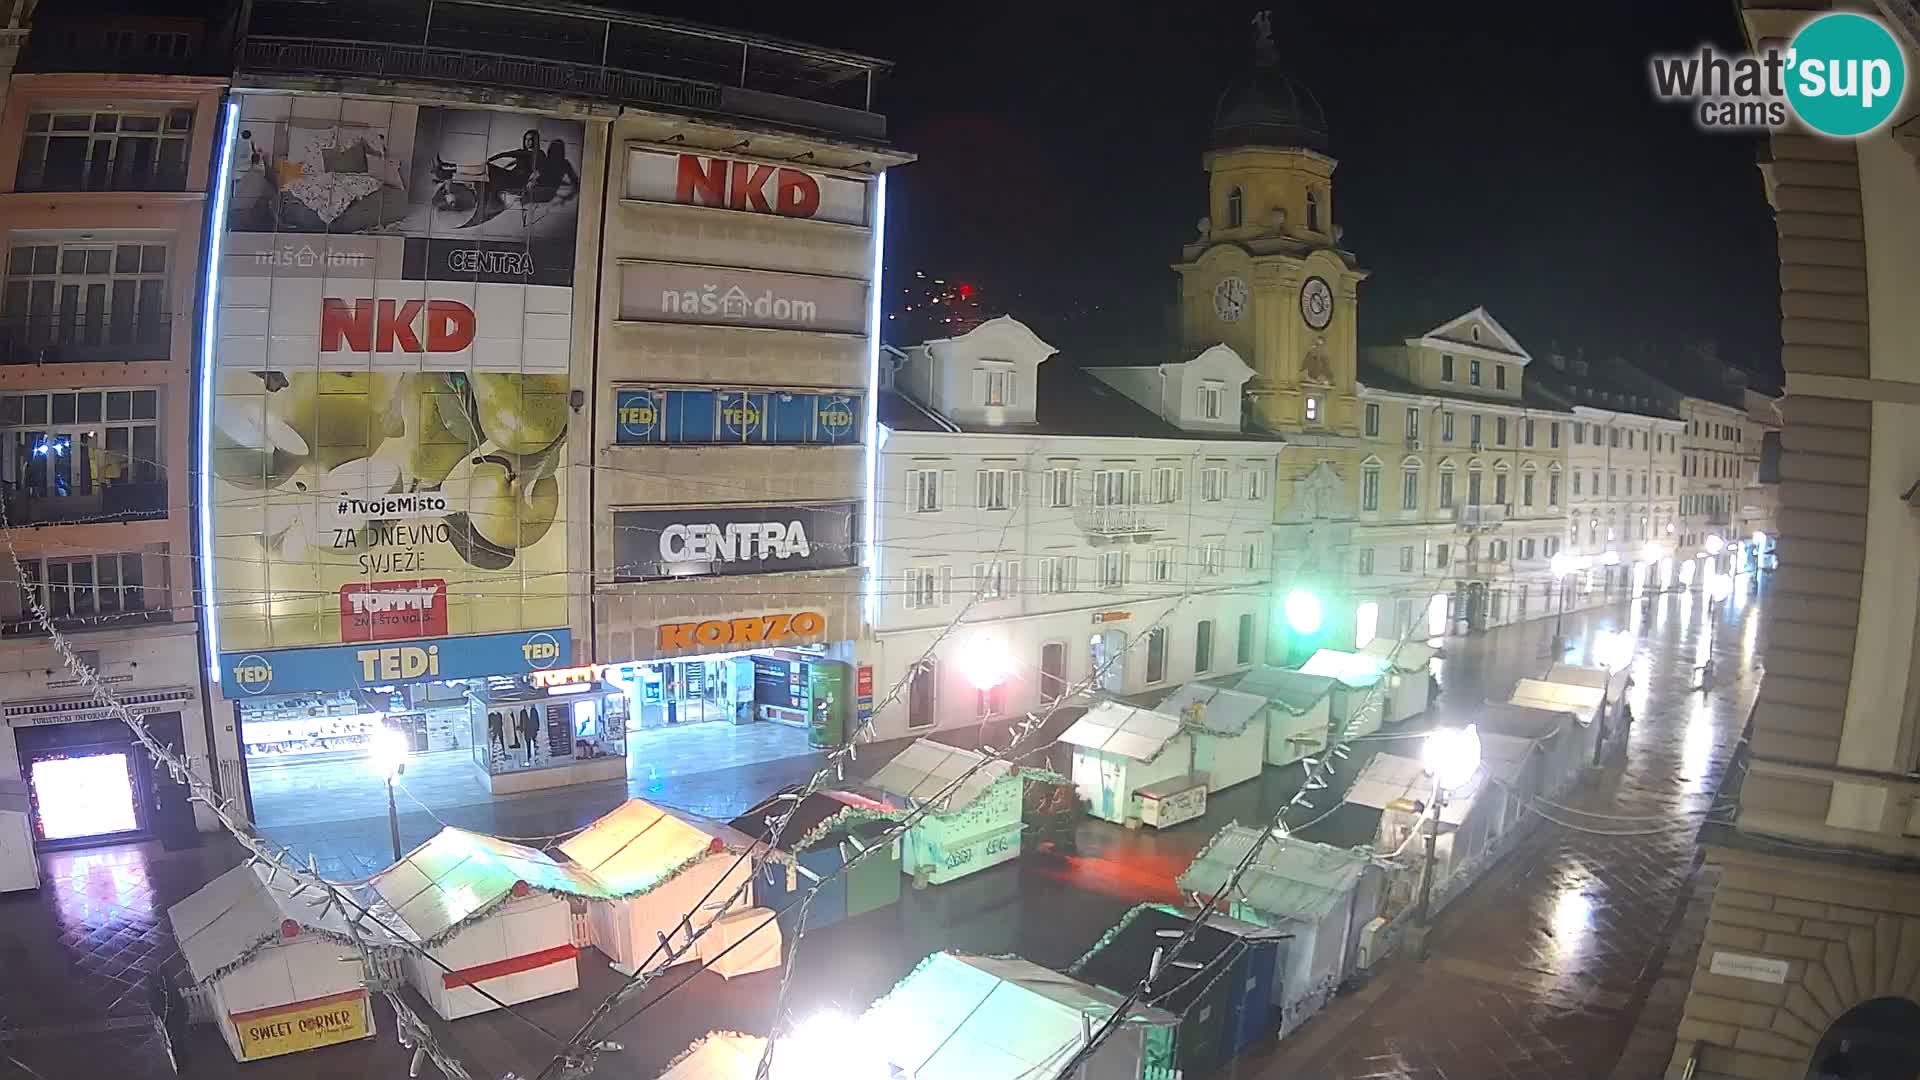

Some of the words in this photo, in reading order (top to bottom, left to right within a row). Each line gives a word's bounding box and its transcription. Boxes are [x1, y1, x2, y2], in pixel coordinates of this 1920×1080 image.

[677, 154, 820, 218] NKD
[448, 249, 535, 275] CENTRA
[661, 284, 718, 314] naš
[754, 289, 817, 322] dom
[321, 298, 476, 352] NKD
[619, 408, 657, 424] TEDi
[723, 409, 760, 424] TEDi
[338, 496, 446, 516] #TvojeMisto
[333, 529, 357, 548] ZA
[367, 523, 450, 547] DNEVNO
[659, 520, 810, 562] CENTRA
[360, 547, 425, 574] SVJEŽE
[348, 584, 439, 614] TOMMY
[659, 611, 827, 651] KORZO
[357, 645, 439, 681] TEDi
[522, 643, 560, 660] TEDi
[233, 666, 273, 683] TEDi
[250, 1021, 292, 1041] SWEET
[298, 1010, 351, 1033] CORNER
